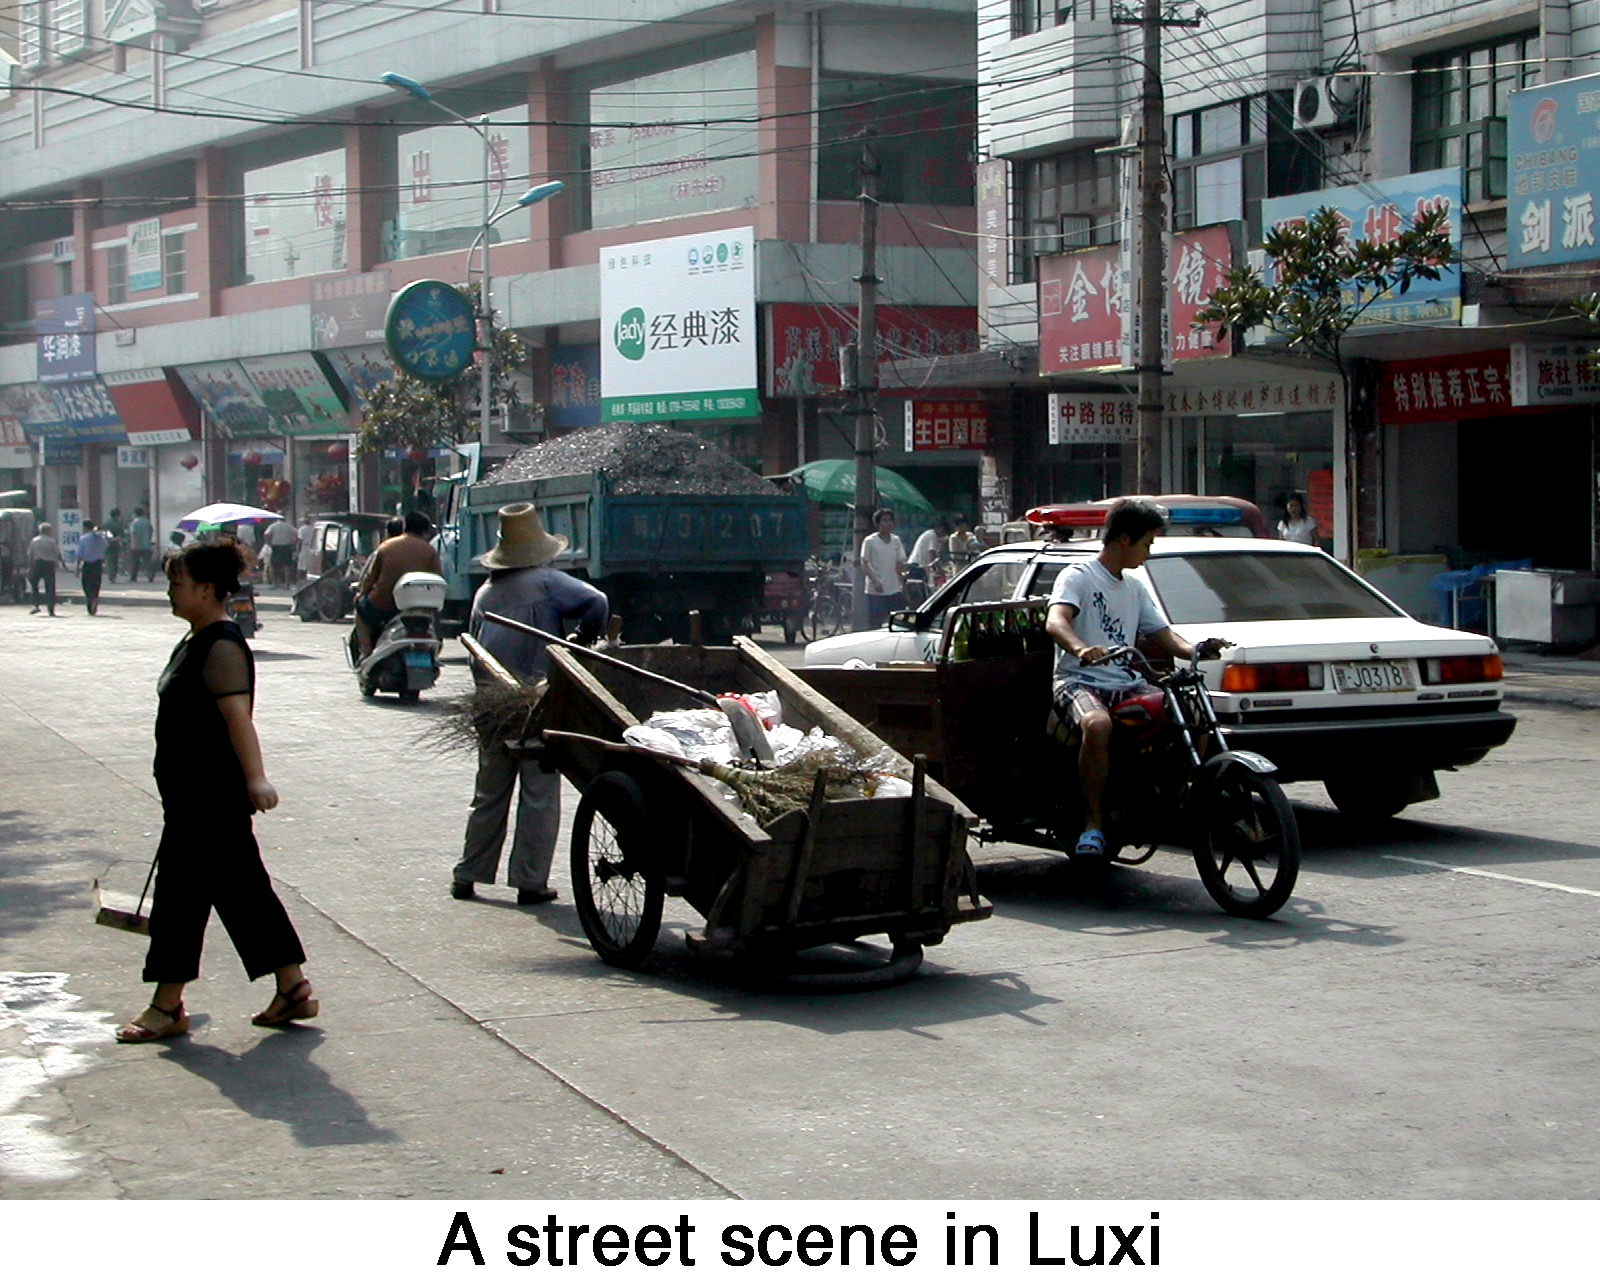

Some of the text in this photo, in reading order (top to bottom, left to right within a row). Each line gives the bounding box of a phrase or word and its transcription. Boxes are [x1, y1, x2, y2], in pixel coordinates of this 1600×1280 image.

[1520, 192, 1596, 255] 剑派
[650, 307, 741, 351] 经典漆
[1394, 363, 1512, 412] 特别推荐正宗
[1061, 401, 1138, 425] 中路招待
